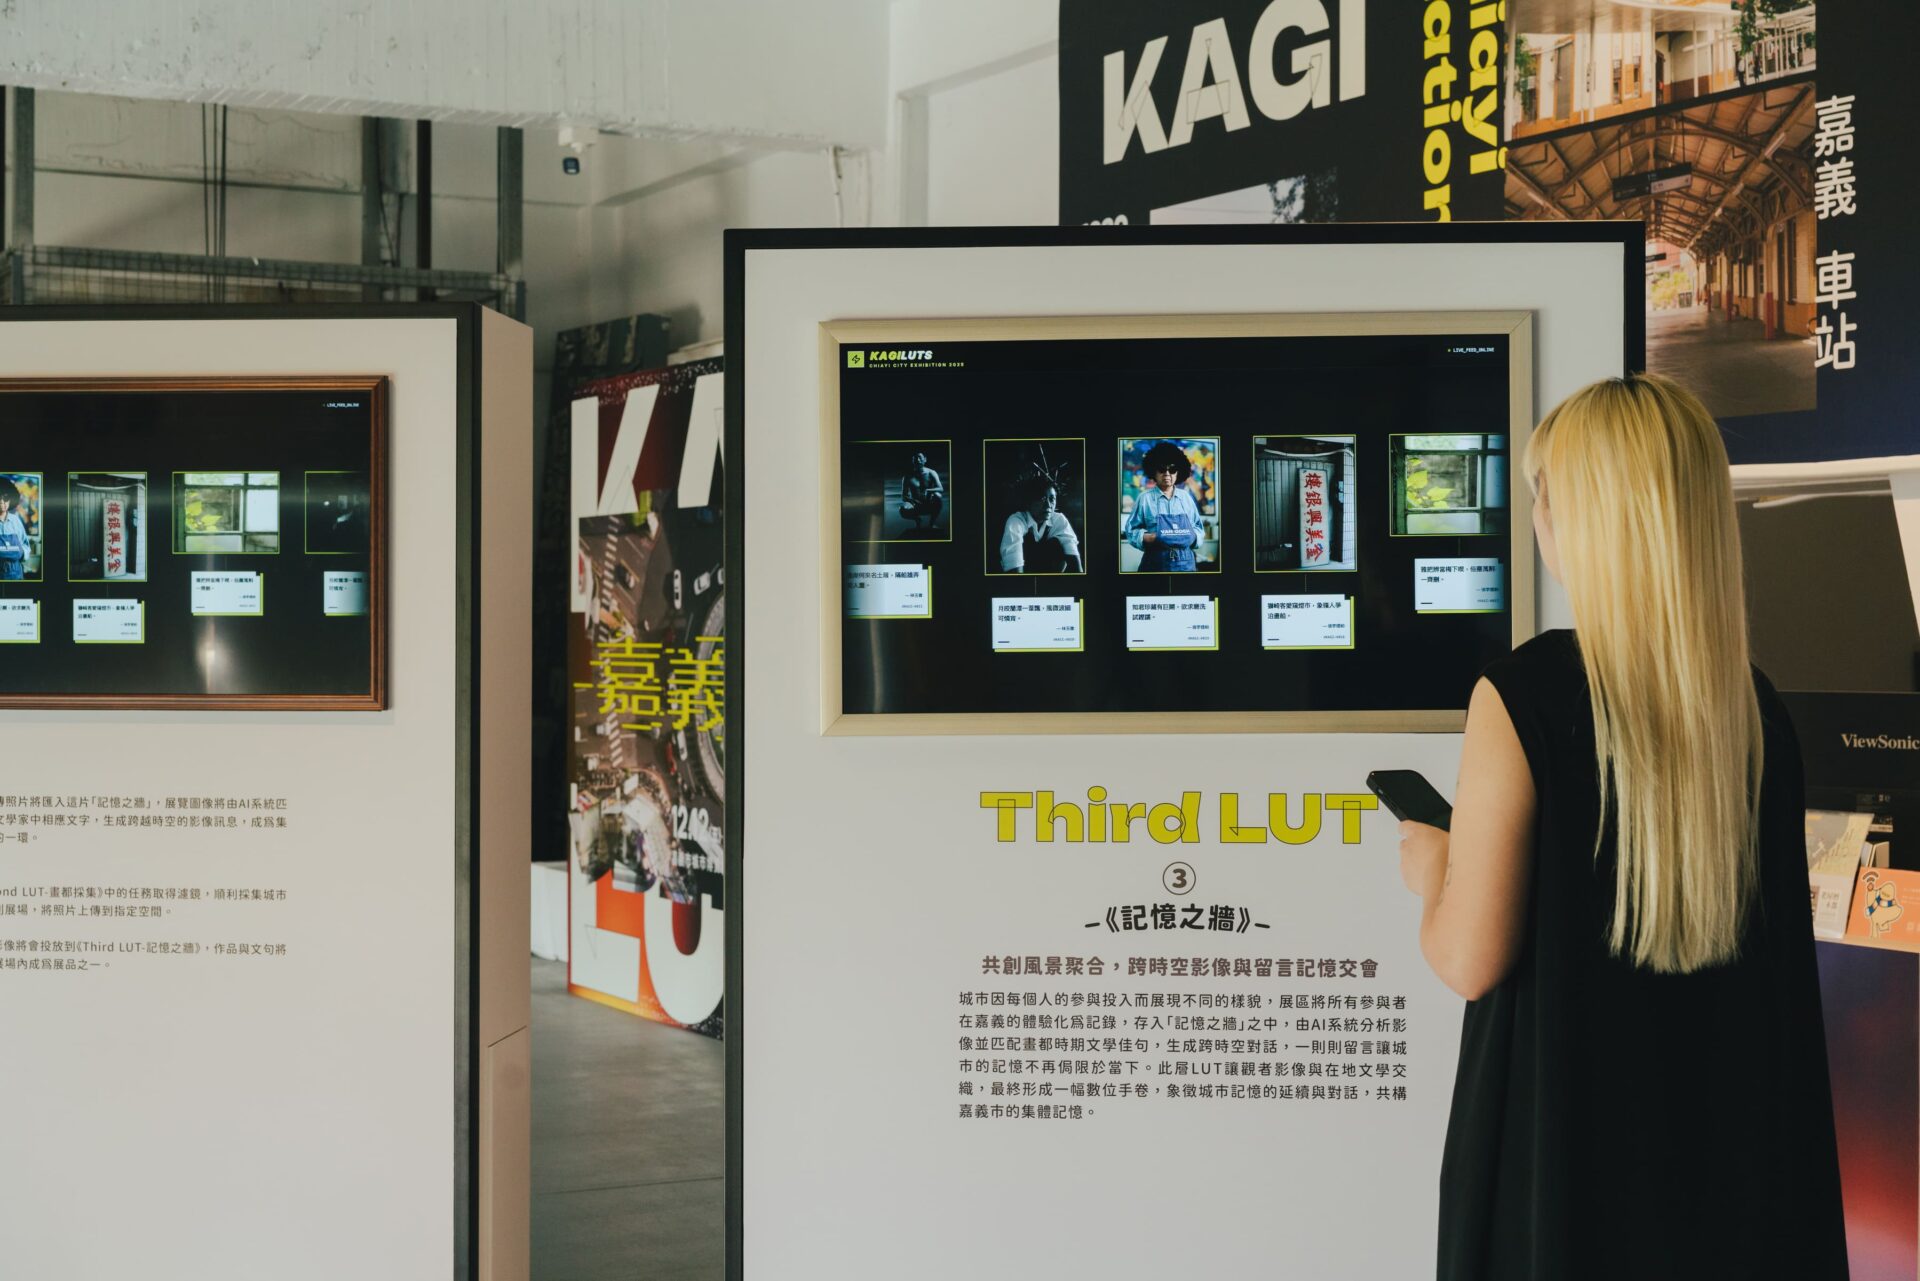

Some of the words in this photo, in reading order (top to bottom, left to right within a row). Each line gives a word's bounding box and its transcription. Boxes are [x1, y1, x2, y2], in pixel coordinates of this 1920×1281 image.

[1103, 0, 1366, 165] KAGI
[1462, 0, 1509, 175] iayi
[1423, 0, 1462, 222] ation
[1814, 94, 1857, 220] 嘉義
[1814, 249, 1857, 371] 車站
[869, 350, 933, 361] KAGILUTS
[1840, 733, 1920, 750] ViewSonic
[980, 785, 1202, 845] Third
[1219, 792, 1379, 845] LUT
[981, 955, 1379, 979] 共創風景聚合，跨時空影像與留言記憶交會
[958, 991, 1407, 1010] 城市因每個人的參與投入而展現不同的樣貌，展區將所有參與者
[958, 1036, 1407, 1056] 像並匹配畫都時期文學佳句，生成跨時空對話，一則則留言讓城
[958, 1058, 1407, 1078] 市的記憶不再侷限於當下。此層LUT讓觀者影像與在地文學交
[958, 1080, 1407, 1100] 織，最終形成一幅數位手卷，象徵城市記憶的延續與對話，共構
[958, 1103, 1095, 1119] 嘉義市的集體記憶。
